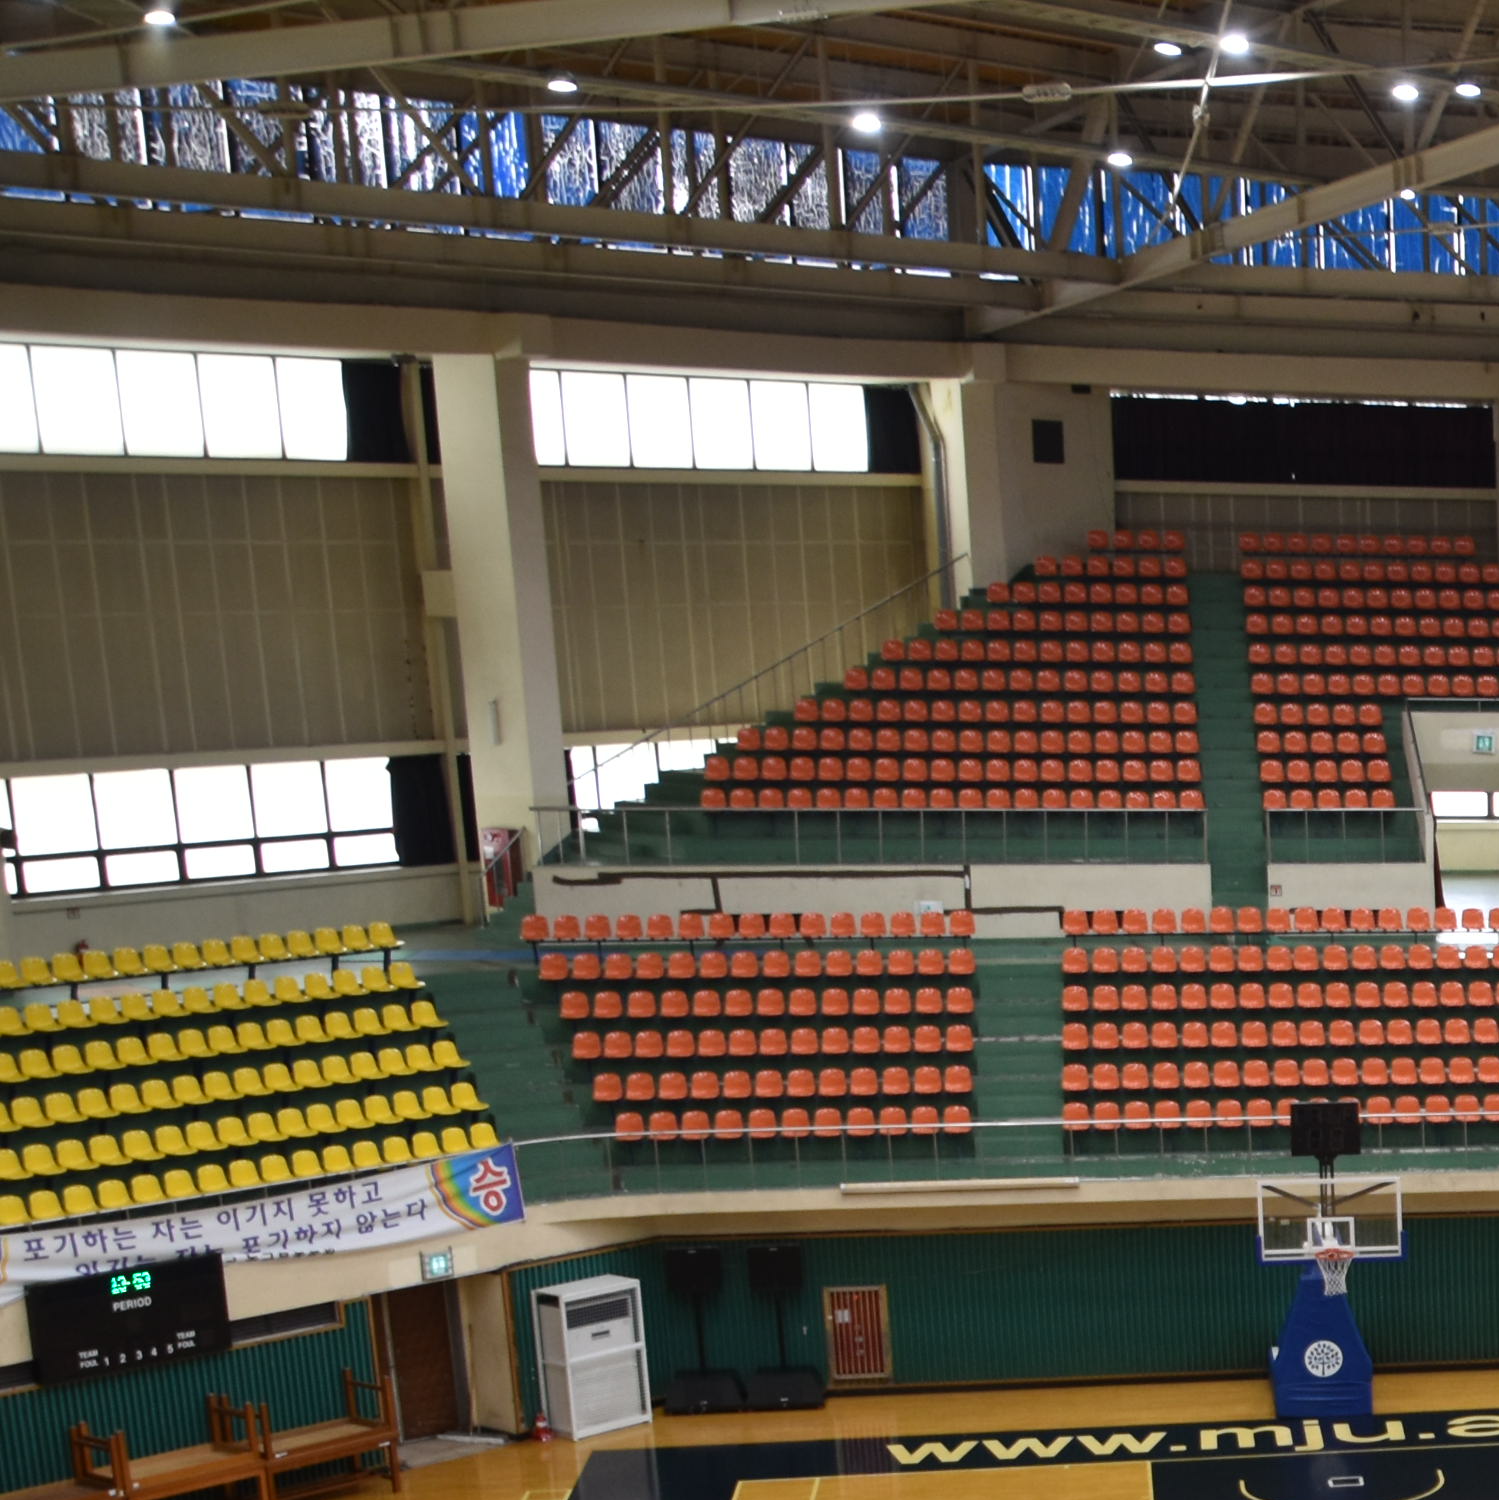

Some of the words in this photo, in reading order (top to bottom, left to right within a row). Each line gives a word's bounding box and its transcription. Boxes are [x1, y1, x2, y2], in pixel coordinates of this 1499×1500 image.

[471, 1157, 510, 1214] 승
[23, 1227, 137, 1262] 포기하는
[151, 1216, 203, 1243] 자는
[216, 1197, 295, 1232] 이기지
[307, 1180, 384, 1218] 못하고
[356, 1198, 428, 1234] 않는다
[112, 1296, 152, 1312] PERIOD
[176, 1330, 196, 1341] TEAM
[177, 1340, 196, 1350] FOUL
[78, 1350, 99, 1360] TEAM
[104, 1357, 110, 1366] 1
[120, 1354, 127, 1364] 2
[136, 1350, 143, 1361] 3
[151, 1347, 158, 1357] 4
[167, 1344, 174, 1354] 5
[80, 1360, 99, 1369] FOUL
